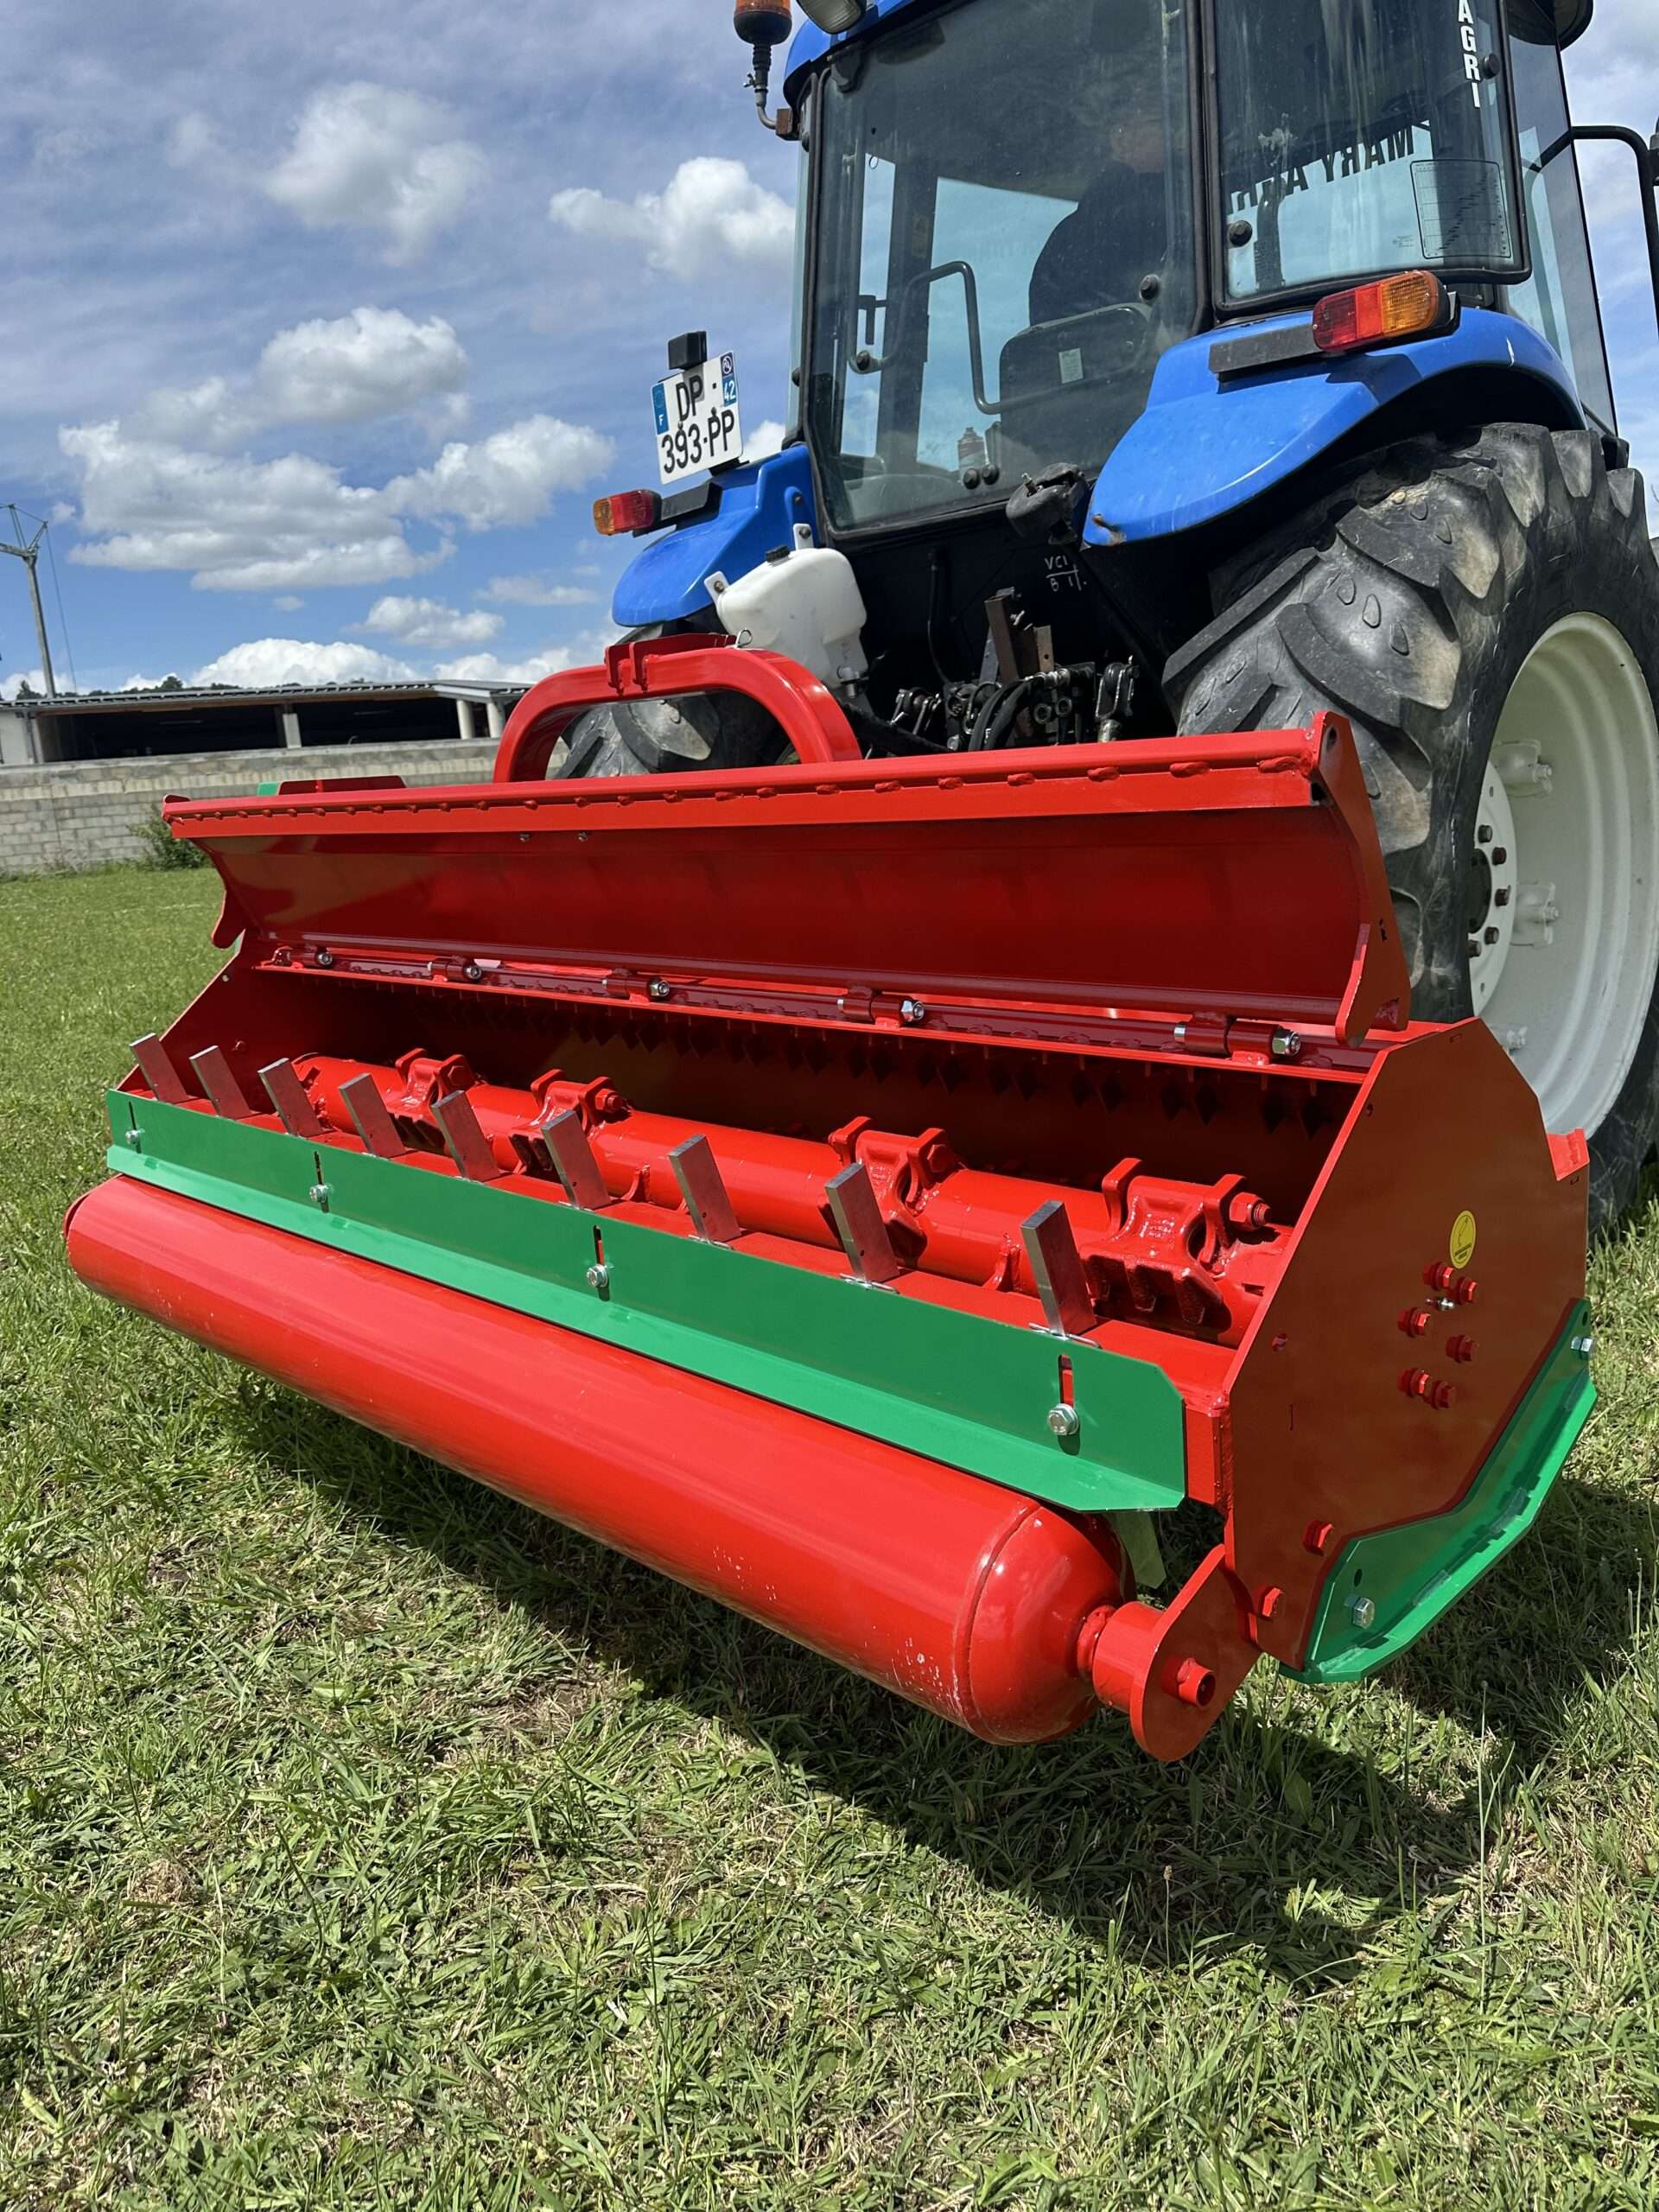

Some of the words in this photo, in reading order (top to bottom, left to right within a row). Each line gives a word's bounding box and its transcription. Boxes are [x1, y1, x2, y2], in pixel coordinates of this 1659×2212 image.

[1458, 0, 1481, 108] AGRI
[675, 373, 704, 422] DP
[723, 379, 735, 403] 42
[658, 414, 664, 426] F
